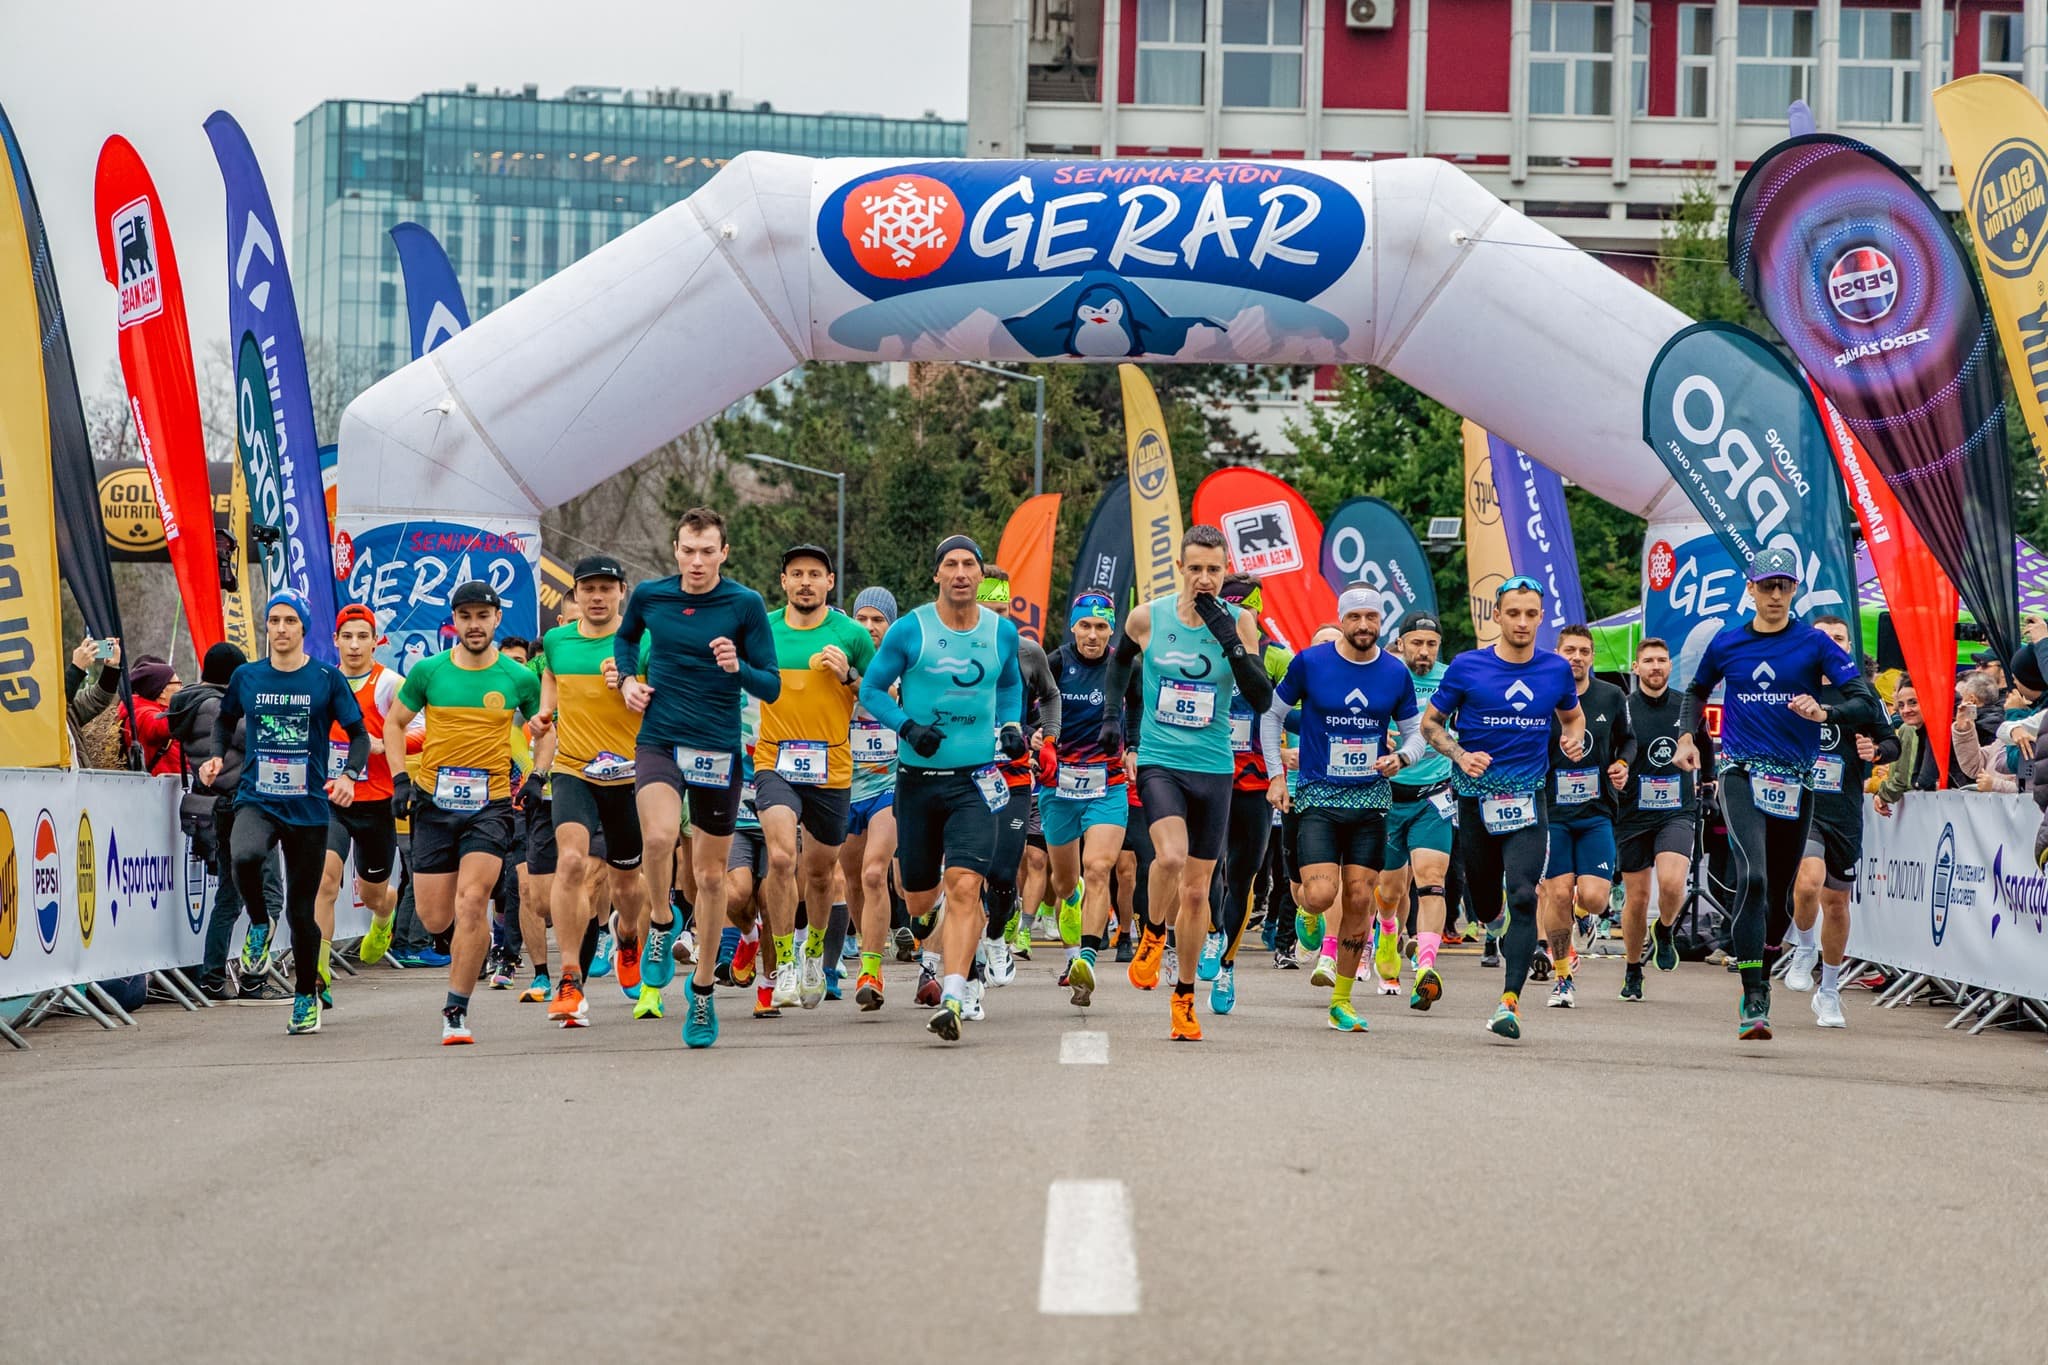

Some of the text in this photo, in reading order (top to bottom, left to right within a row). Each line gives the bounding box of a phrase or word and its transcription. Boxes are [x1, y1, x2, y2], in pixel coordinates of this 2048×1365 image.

[969, 175, 1322, 271] GERAR
[110, 484, 153, 503] GOL
[105, 505, 161, 519] NUTRITI
[256, 694, 310, 705] STATE OF MIND
[1176, 700, 1195, 713] 85
[1326, 715, 1379, 730] sportguru
[867, 738, 881, 750] 16
[694, 757, 713, 771] 85
[794, 759, 810, 771] 95
[1342, 752, 1367, 766] 169
[273, 772, 290, 784] 35
[1813, 768, 1827, 779] 75
[1074, 777, 1089, 789] 77
[1572, 782, 1585, 793] 75
[454, 786, 471, 798] 95
[1654, 790, 1668, 799] 75
[1762, 787, 1786, 802] 169
[1496, 806, 1522, 820] 169
[35, 867, 59, 895] PEPSI
[122, 849, 174, 909] sportguru
[2005, 868, 2048, 934] sportg
